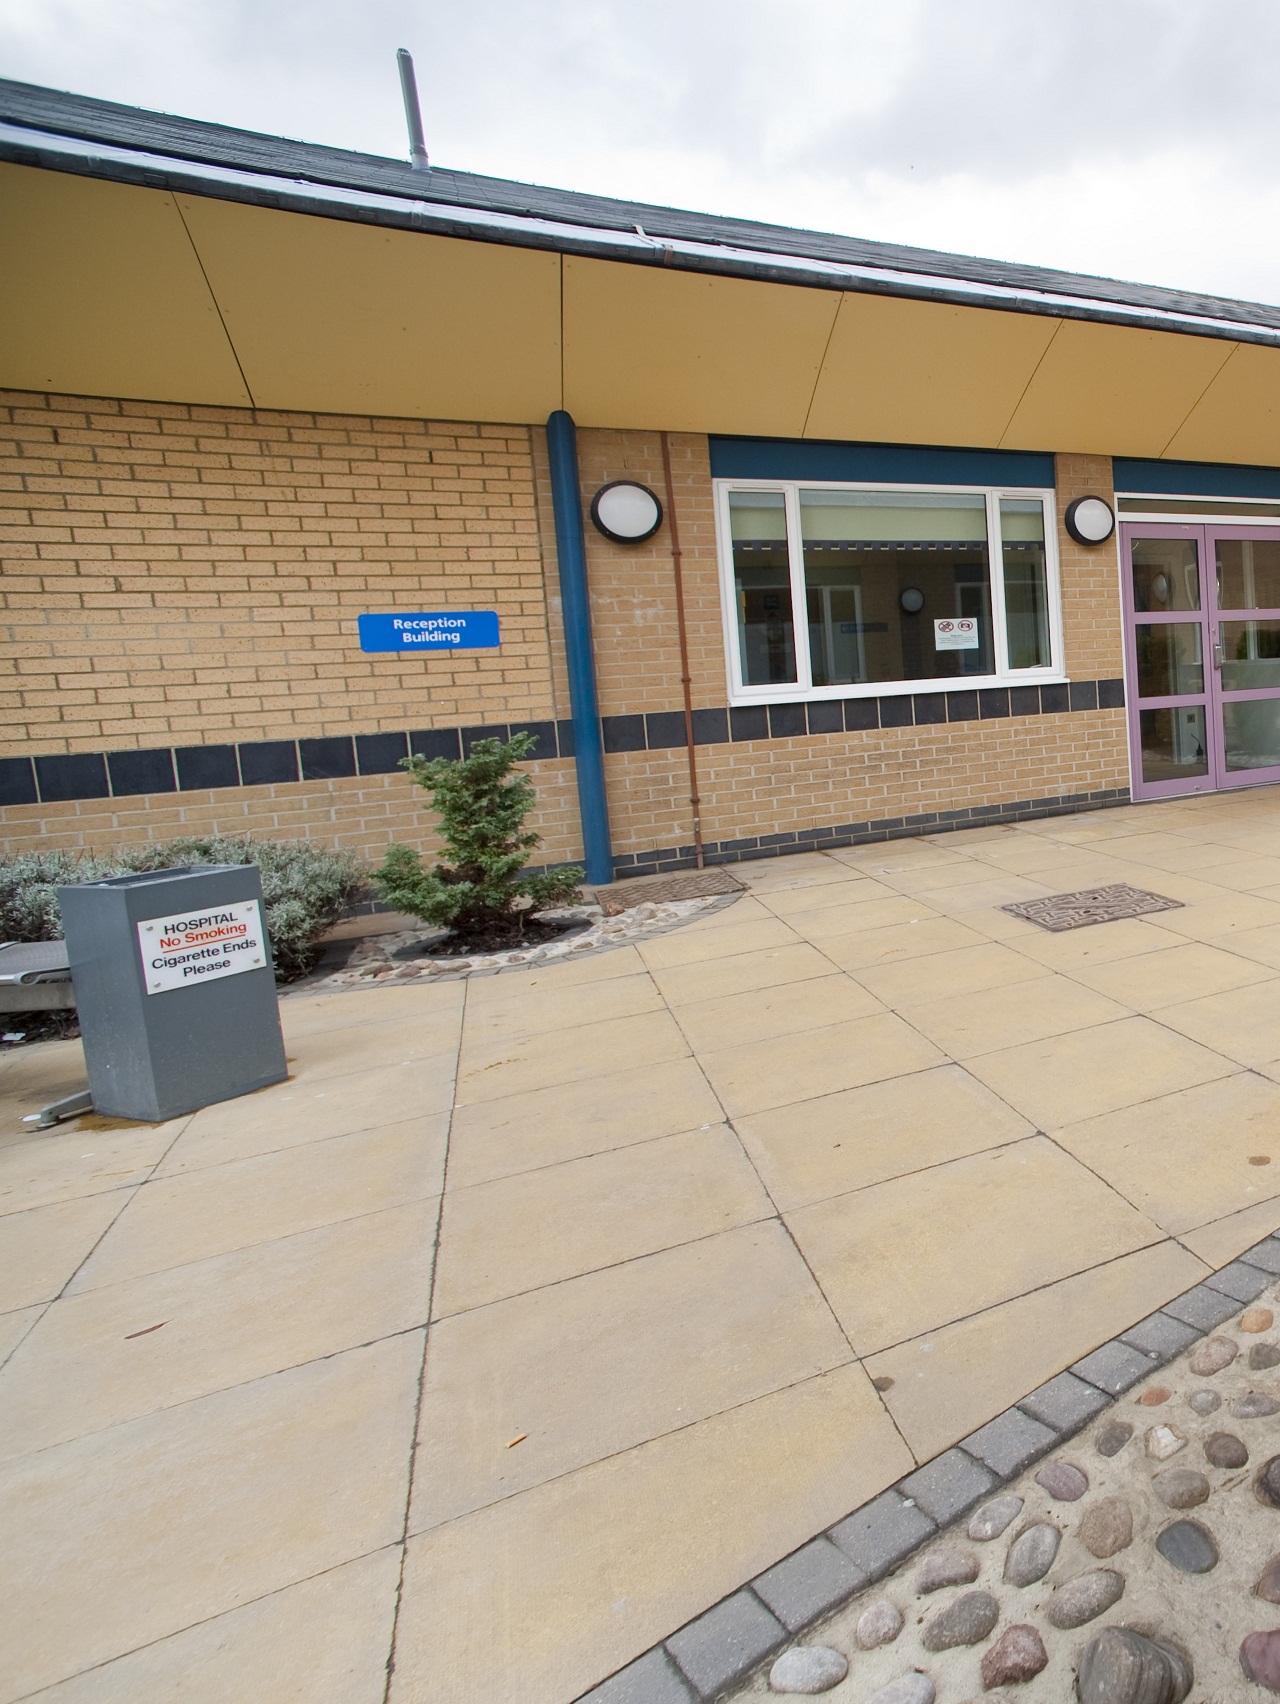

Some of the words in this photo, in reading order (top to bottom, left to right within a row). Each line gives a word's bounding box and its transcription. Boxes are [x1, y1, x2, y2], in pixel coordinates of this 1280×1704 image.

[393, 617, 466, 630] Reception
[402, 632, 460, 643] Building
[164, 912, 238, 935] HOSPITAL
[159, 937, 181, 948] No
[184, 923, 247, 943] Smoking
[151, 948, 220, 969] Cigarette
[223, 939, 257, 953] Ends
[183, 959, 231, 977] Please
